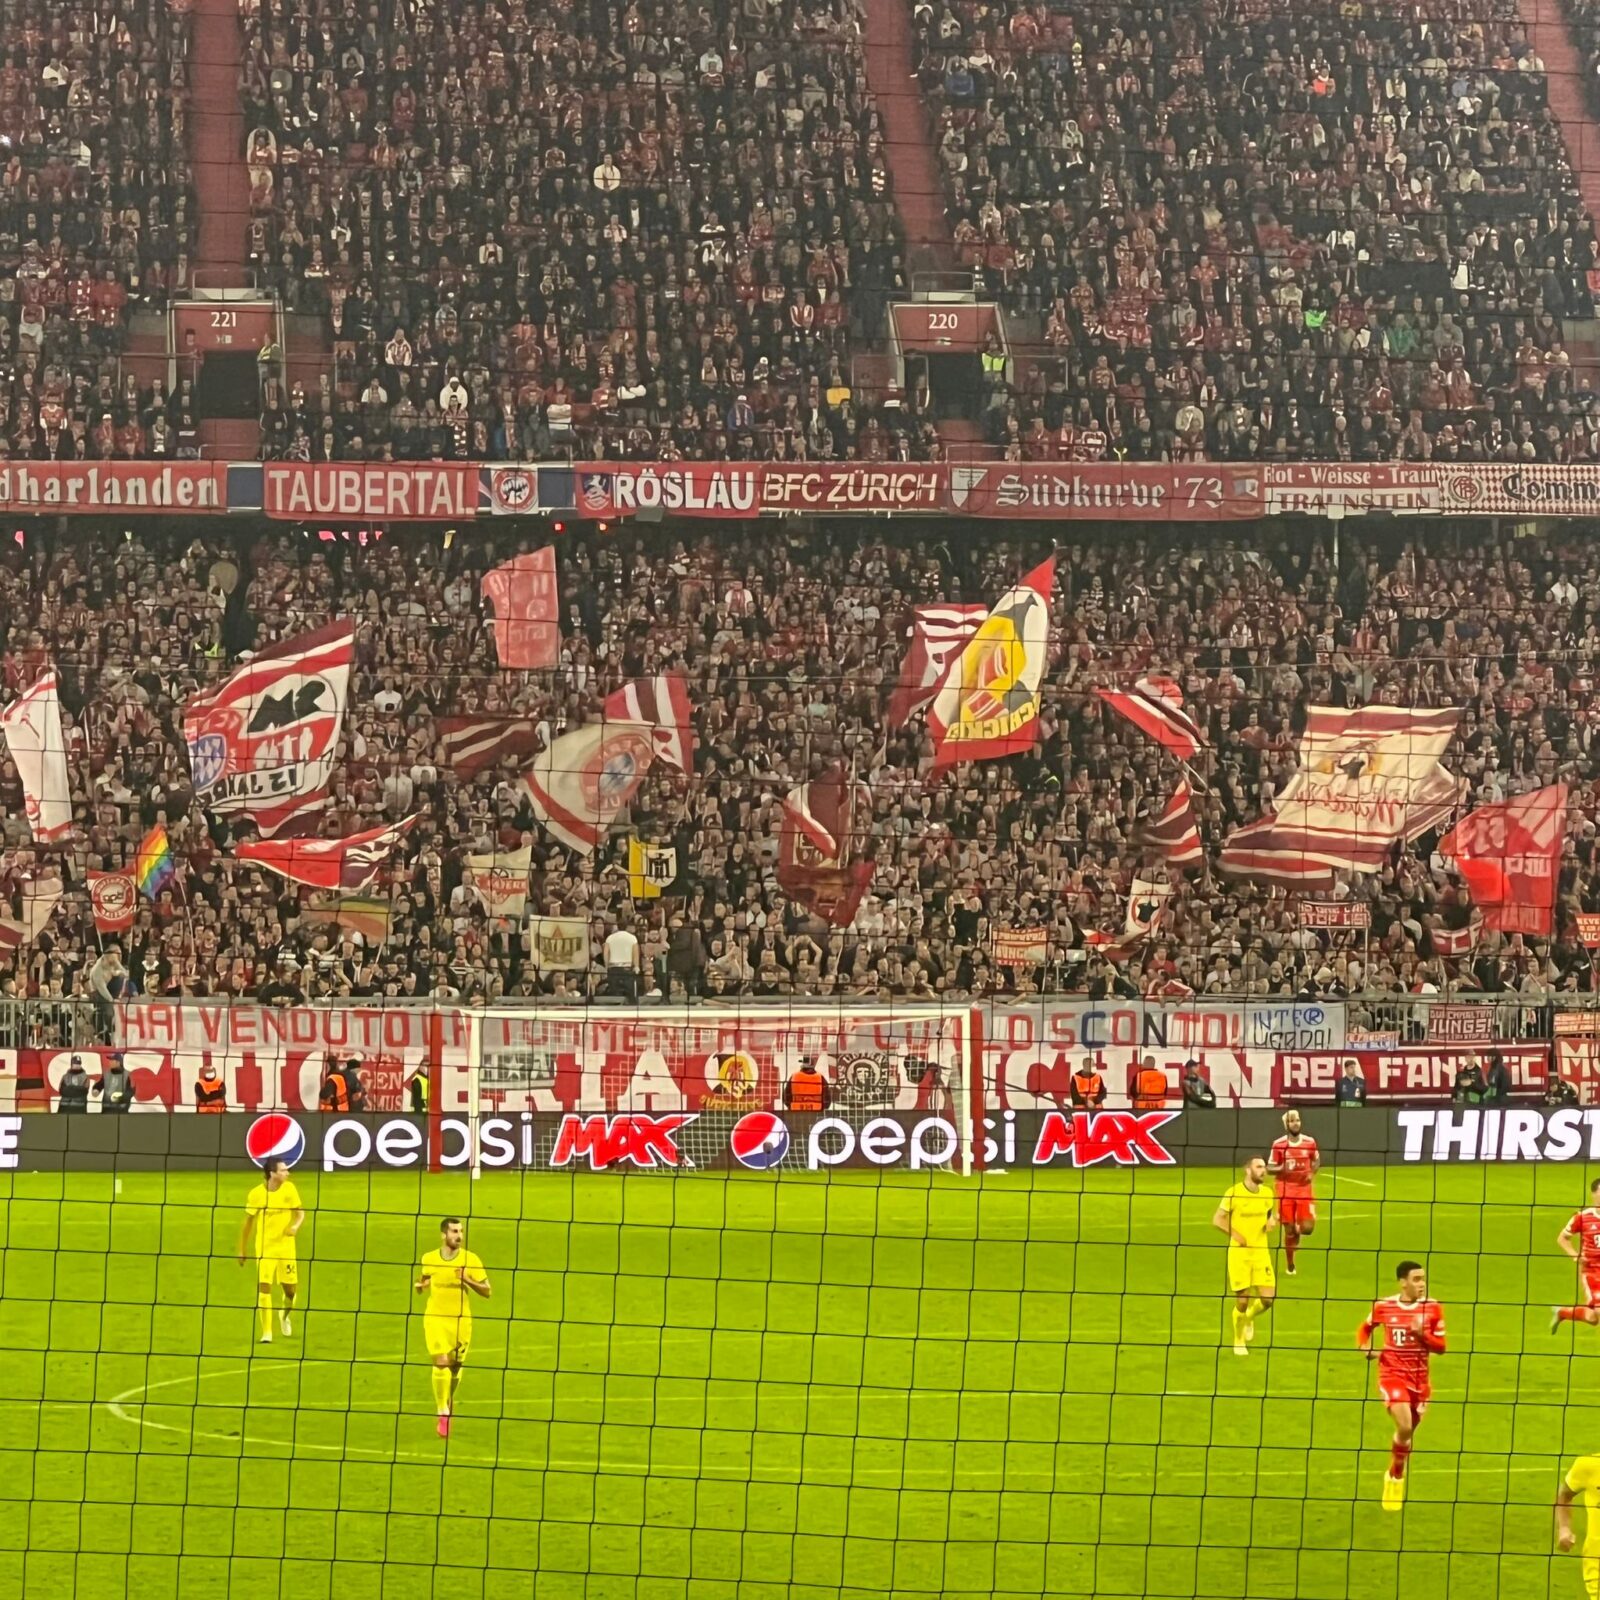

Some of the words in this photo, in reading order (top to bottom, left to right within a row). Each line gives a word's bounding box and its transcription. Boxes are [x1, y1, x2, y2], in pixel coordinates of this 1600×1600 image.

[210, 311, 237, 327] 221
[928, 313, 958, 329] 220
[268, 470, 476, 515] TAUBERTAL
[612, 467, 754, 510] RÖSLAU
[763, 473, 823, 502] BFC
[826, 469, 938, 502] ZÜRICH
[995, 474, 1166, 508] Südkurve
[1276, 493, 1432, 510] TRAUNSTEIN
[118, 1003, 184, 1042] HAI
[200, 1005, 411, 1048] VENDUTO
[1050, 1009, 1241, 1050] SCONTO!
[1429, 1018, 1492, 1034] JUNGS!
[323, 1112, 532, 1172] pepsi
[549, 1113, 701, 1170] MAX
[1032, 1110, 1182, 1168] MAX
